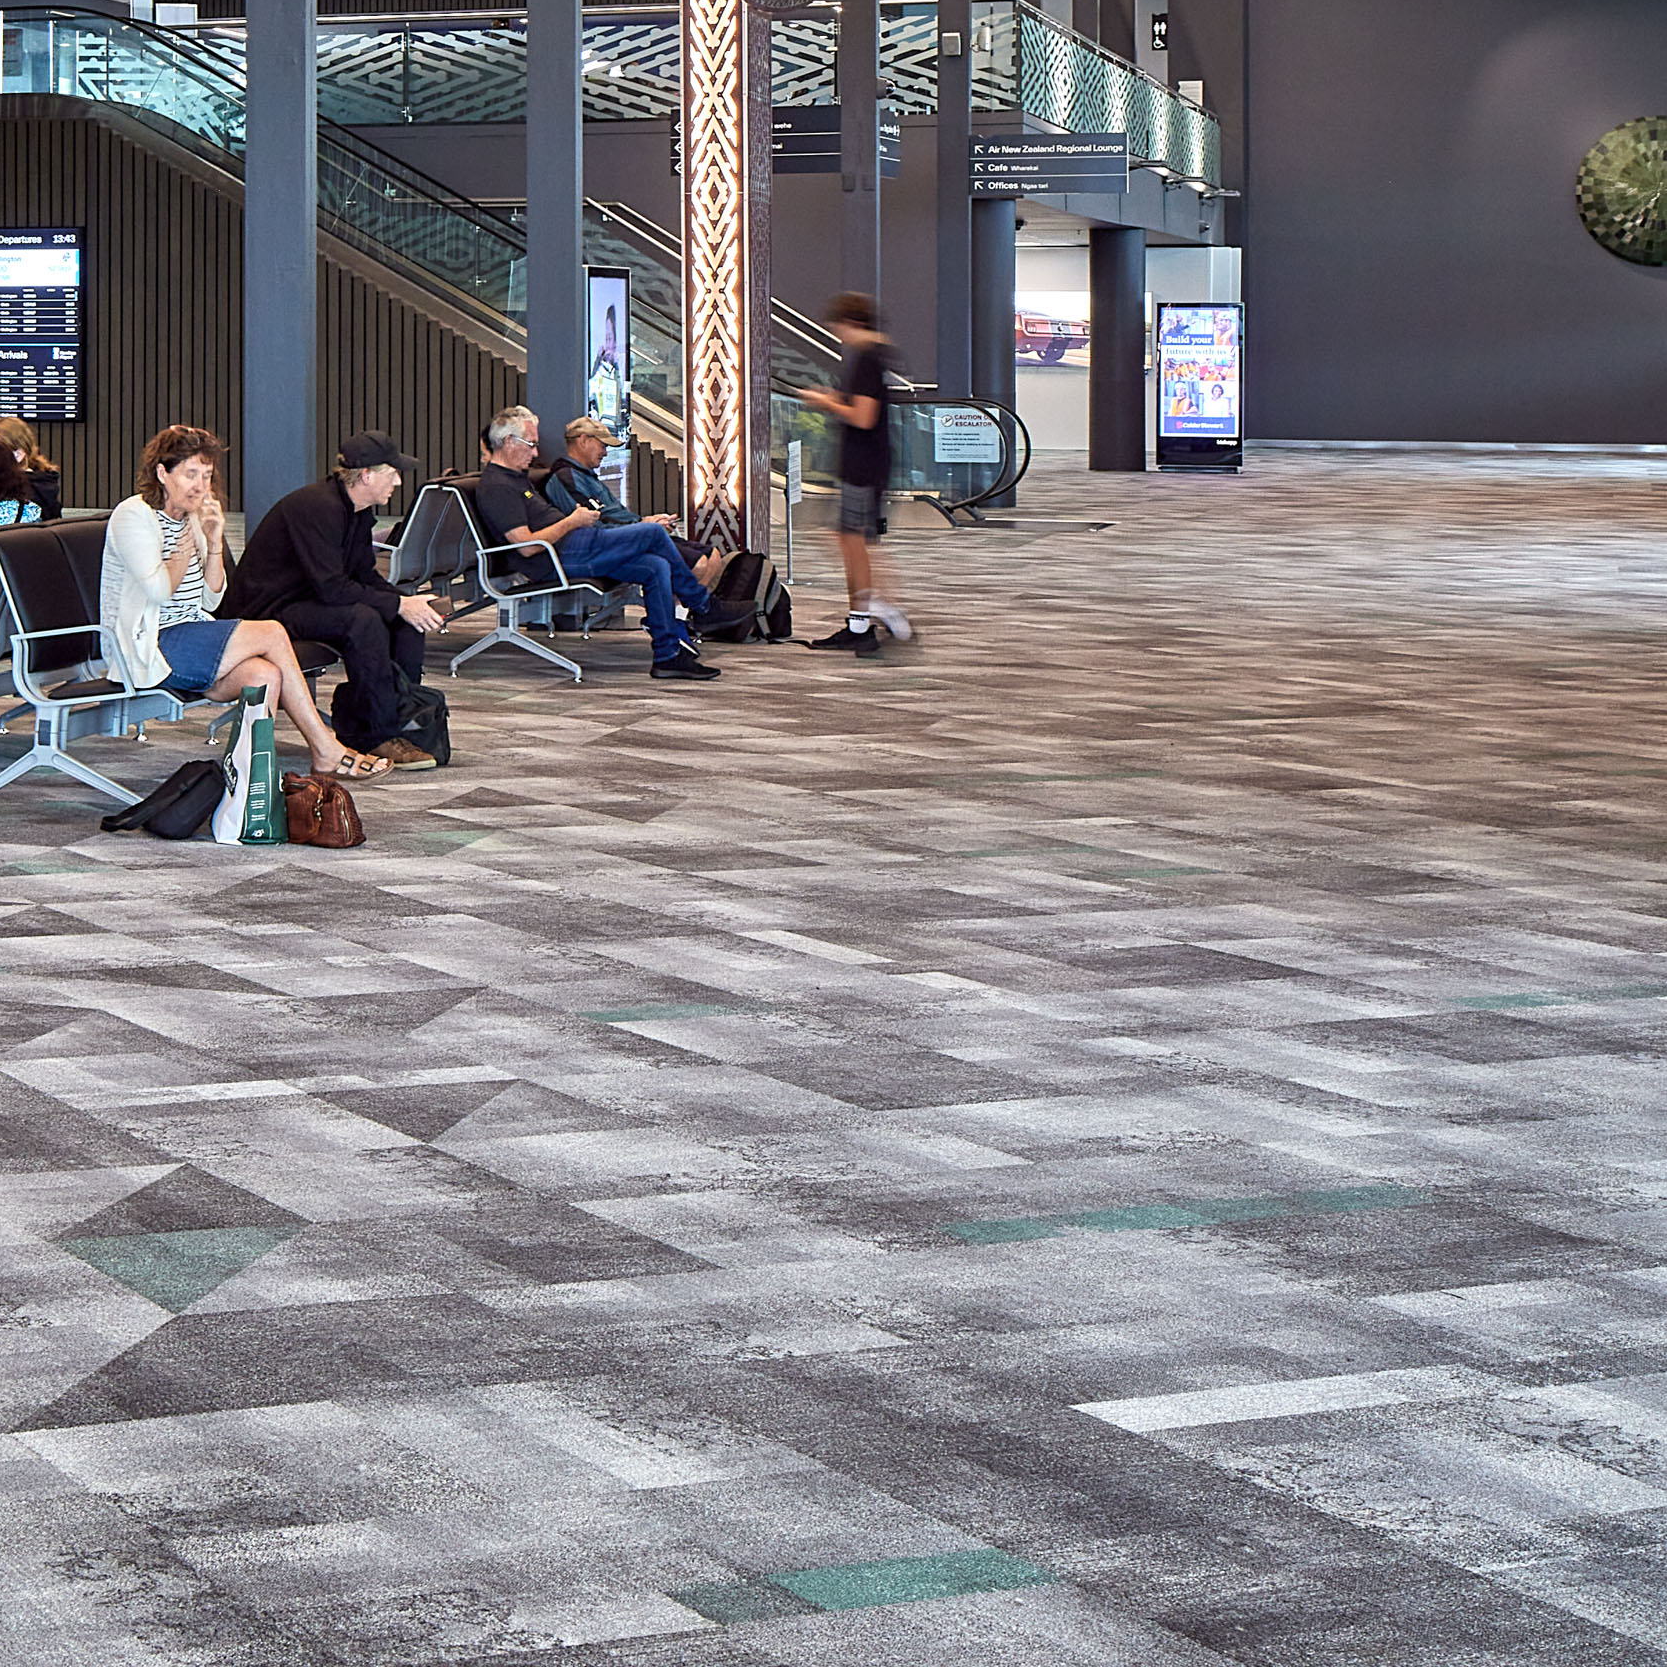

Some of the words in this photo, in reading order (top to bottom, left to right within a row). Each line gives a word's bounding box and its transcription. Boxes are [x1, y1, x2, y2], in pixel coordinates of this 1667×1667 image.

[988, 145, 1000, 154] Air
[1001, 145, 1022, 154] New
[1022, 144, 1055, 153] Zealand
[1056, 144, 1092, 154] Regional
[1093, 144, 1124, 153] Lounge
[988, 163, 1009, 172] Cafe
[988, 181, 1019, 190] Offices
[52, 234, 76, 244] 13:43
[1165, 335, 1190, 344] Build
[1190, 337, 1213, 346] your
